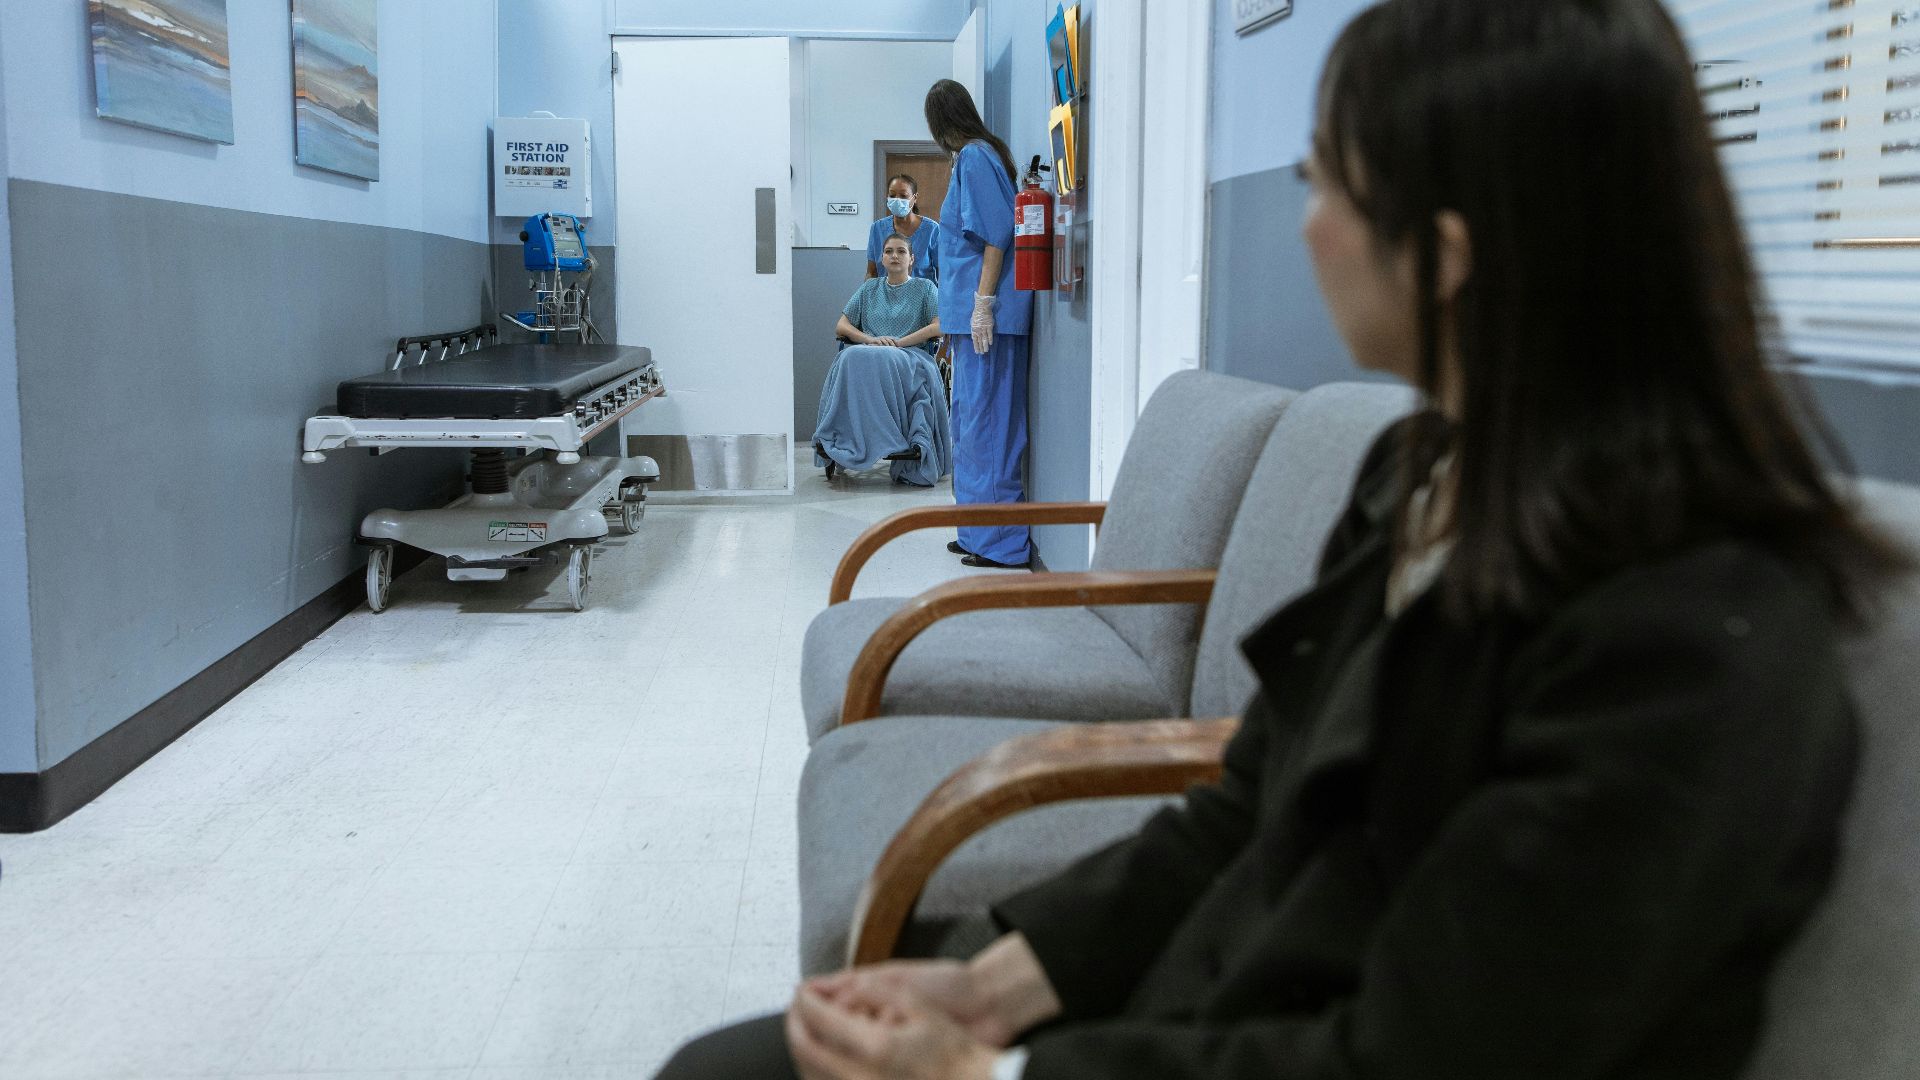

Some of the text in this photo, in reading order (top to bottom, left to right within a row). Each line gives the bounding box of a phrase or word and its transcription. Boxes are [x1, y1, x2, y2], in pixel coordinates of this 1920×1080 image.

[506, 142, 569, 153] FIRST AID
[511, 153, 565, 163] STATION
